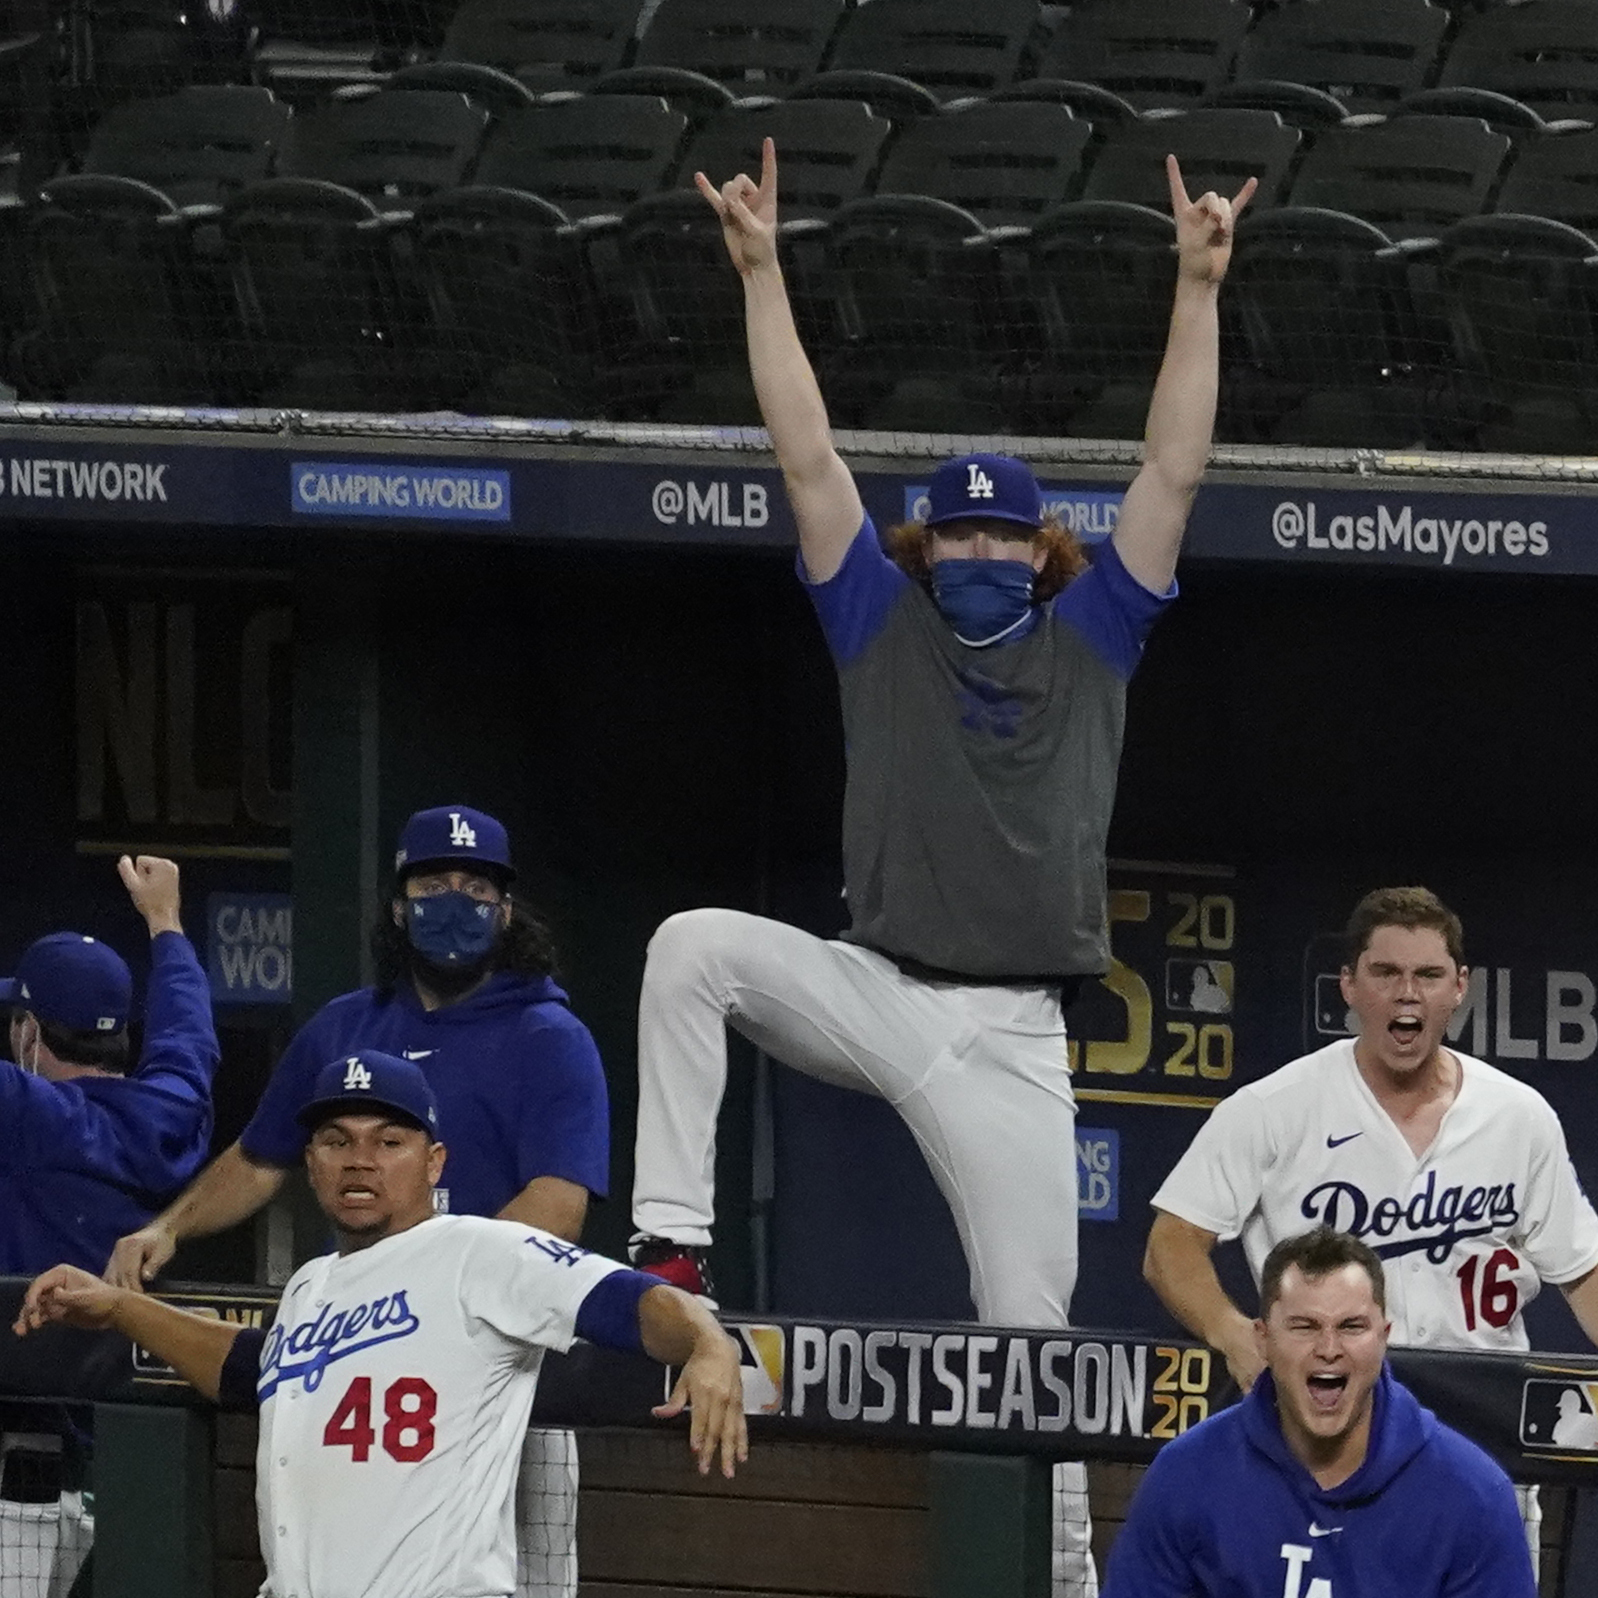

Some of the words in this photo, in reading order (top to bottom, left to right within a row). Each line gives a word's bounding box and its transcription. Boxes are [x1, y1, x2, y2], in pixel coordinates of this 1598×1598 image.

[11, 459, 168, 501] NETWORK
[299, 473, 409, 507] CAMPING
[413, 478, 502, 511] WORLD
[652, 480, 769, 528] @MLB
[967, 464, 994, 498] LA
[1272, 502, 1548, 563] @LasMayores
[449, 813, 477, 848] LA
[1166, 892, 1235, 951] 20
[344, 1057, 371, 1090] LA
[1164, 1022, 1234, 1081] 20
[1301, 1170, 1519, 1265] Dodgers
[1456, 1247, 1520, 1332] 16
[791, 1326, 1148, 1438] POSTSEASON
[1152, 1346, 1211, 1395] 20
[322, 1376, 438, 1464] 48
